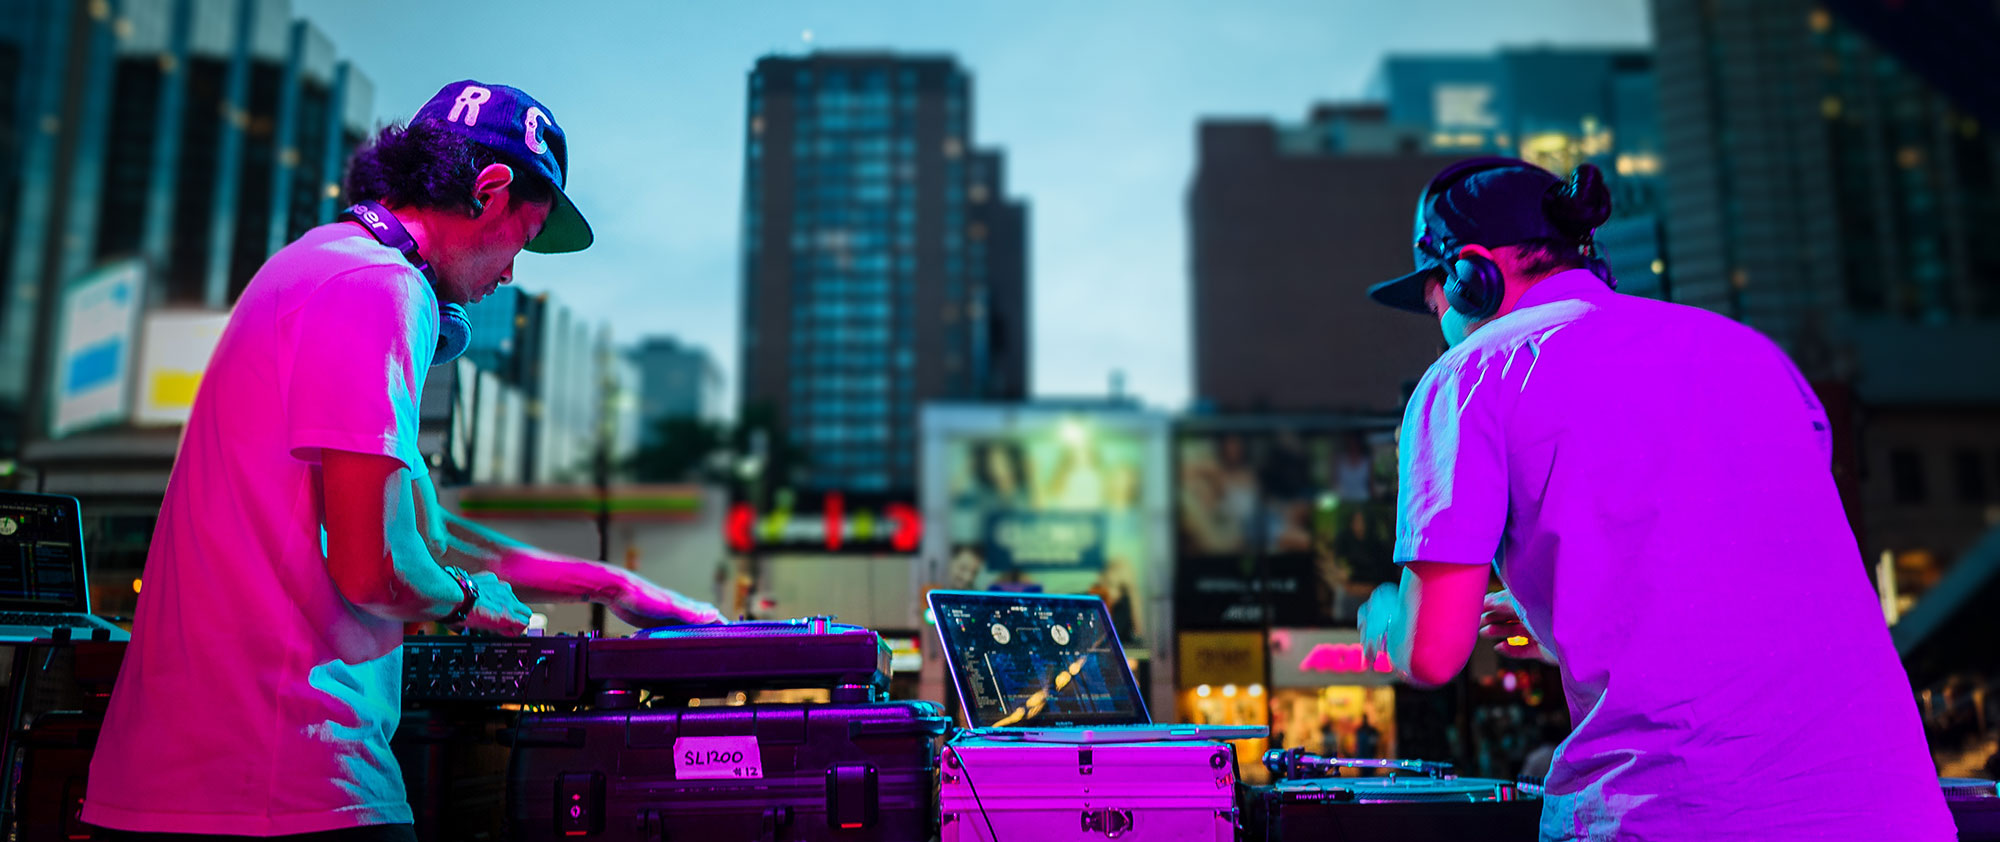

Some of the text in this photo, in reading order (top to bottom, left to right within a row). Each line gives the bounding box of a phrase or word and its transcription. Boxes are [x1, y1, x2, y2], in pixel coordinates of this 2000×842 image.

[448, 86, 551, 154] R C
[685, 750, 743, 765] SL1200
